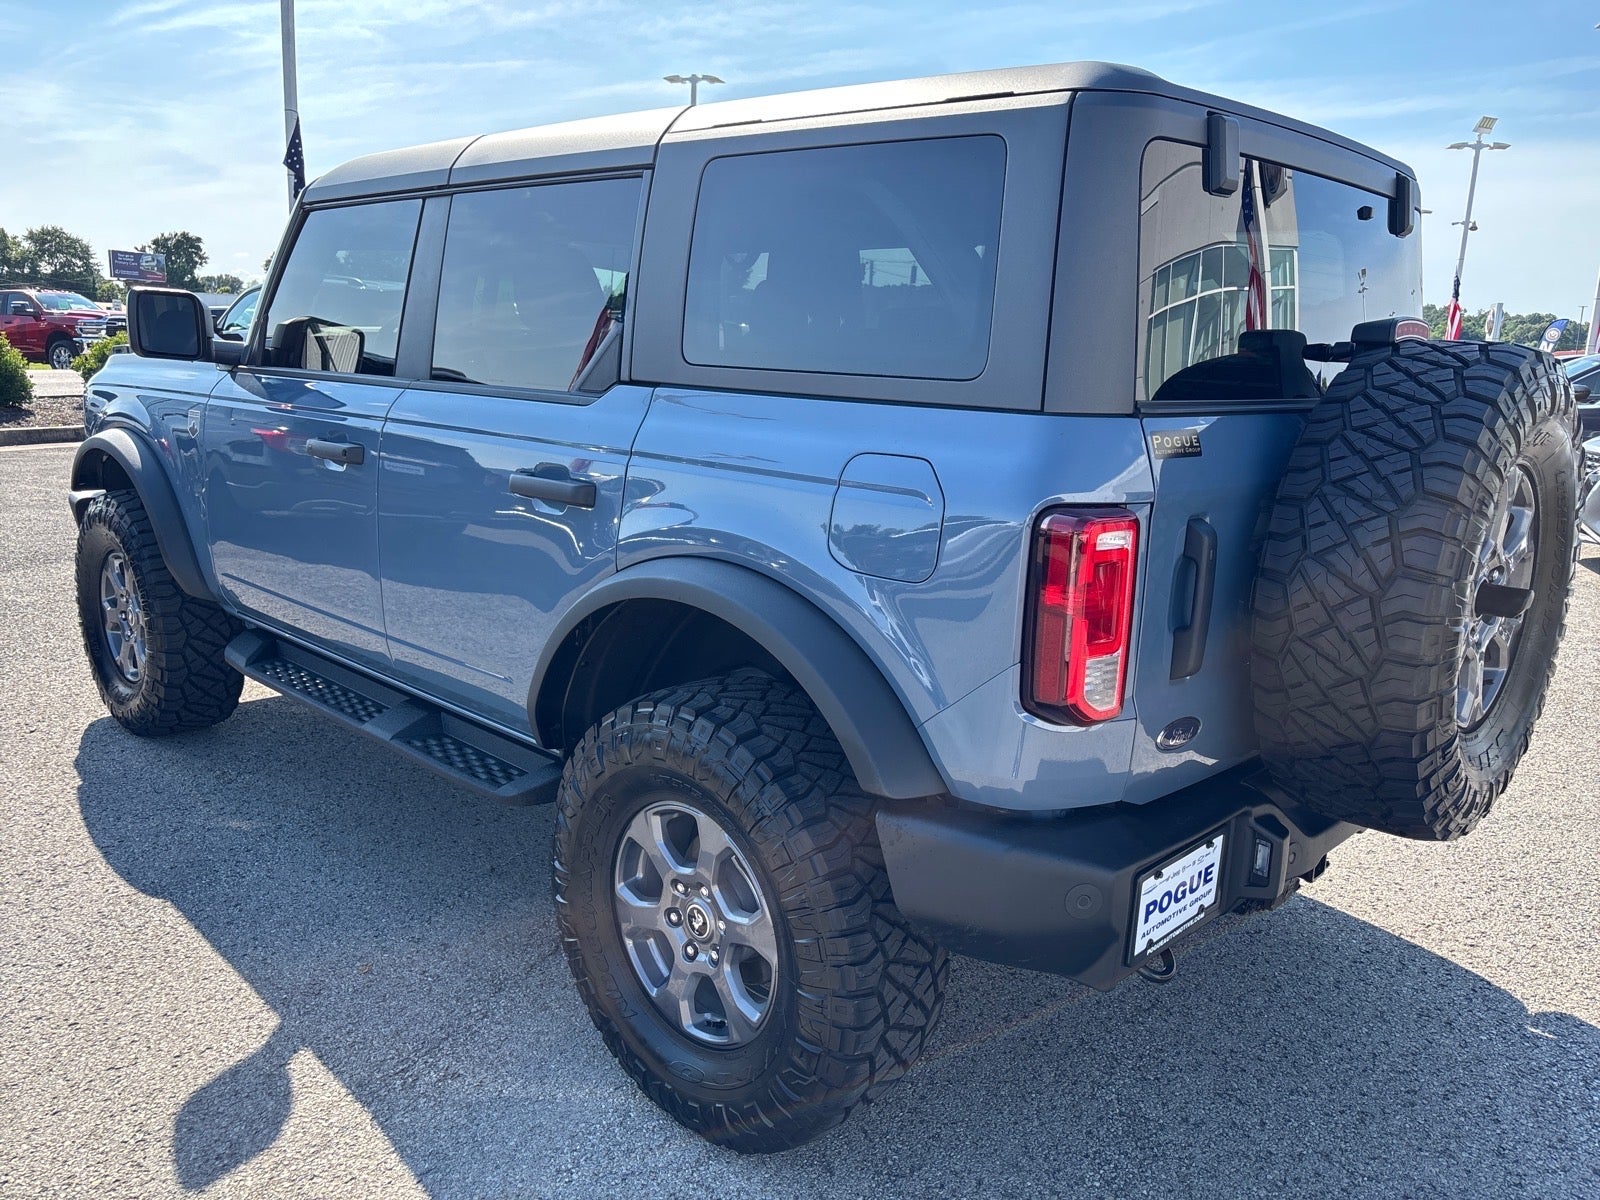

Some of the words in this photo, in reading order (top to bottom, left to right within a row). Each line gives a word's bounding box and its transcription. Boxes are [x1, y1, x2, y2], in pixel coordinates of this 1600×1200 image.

[1152, 435, 1199, 448] POGUE
[1141, 904, 1188, 940] AUTOMOTIVE
[1189, 888, 1213, 907] GROUP
[1144, 862, 1215, 925] POGUE
